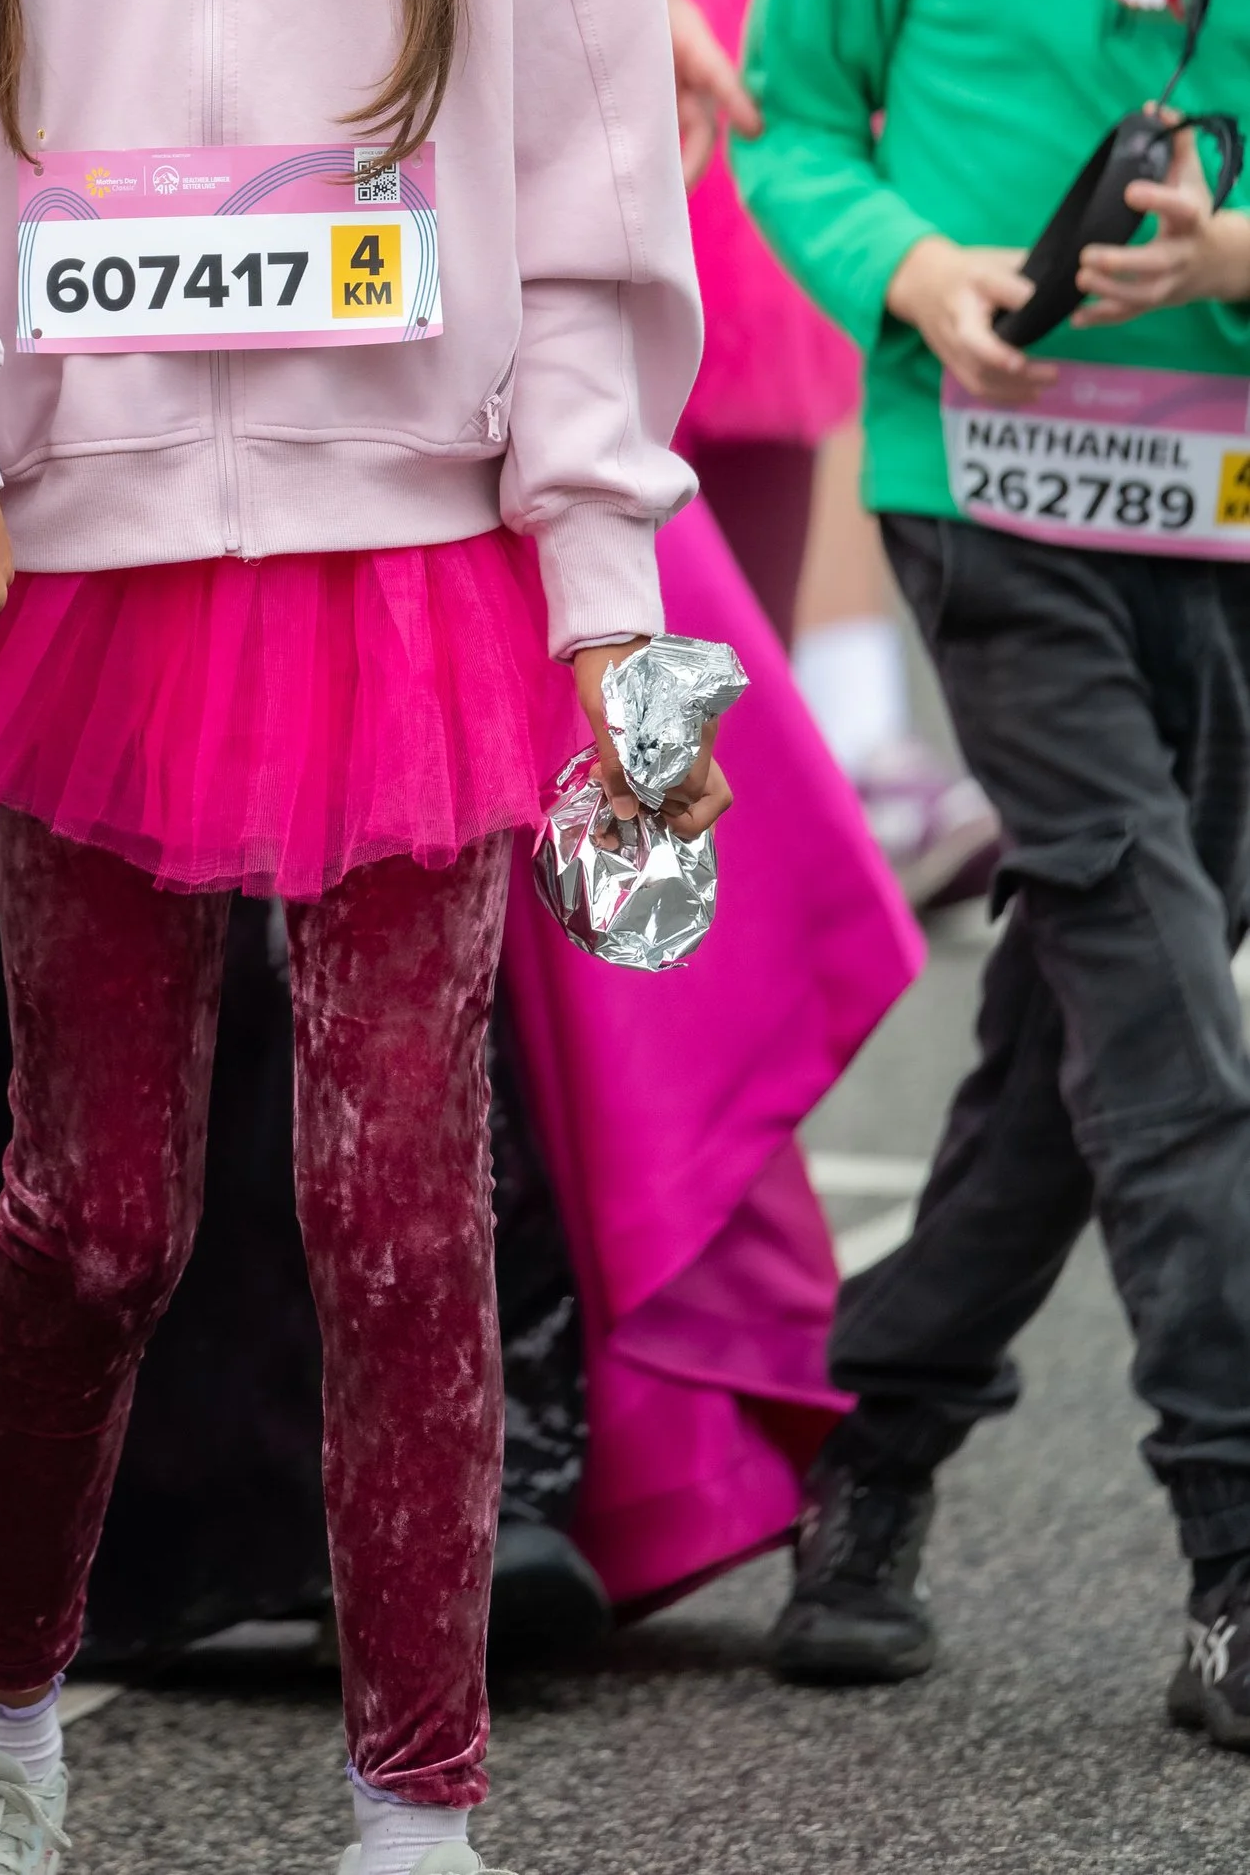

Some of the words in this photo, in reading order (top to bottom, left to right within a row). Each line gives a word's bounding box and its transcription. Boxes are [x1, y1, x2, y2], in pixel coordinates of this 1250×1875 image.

[96, 177, 124, 185] Mother's
[124, 177, 137, 187] Day
[111, 184, 135, 192] Classic
[155, 184, 178, 195] AIA
[46, 251, 309, 314] 607417
[350, 235, 385, 276] 4
[343, 281, 392, 306] KM
[966, 418, 1189, 470] NATHANIEL
[963, 459, 1196, 531] 262789
